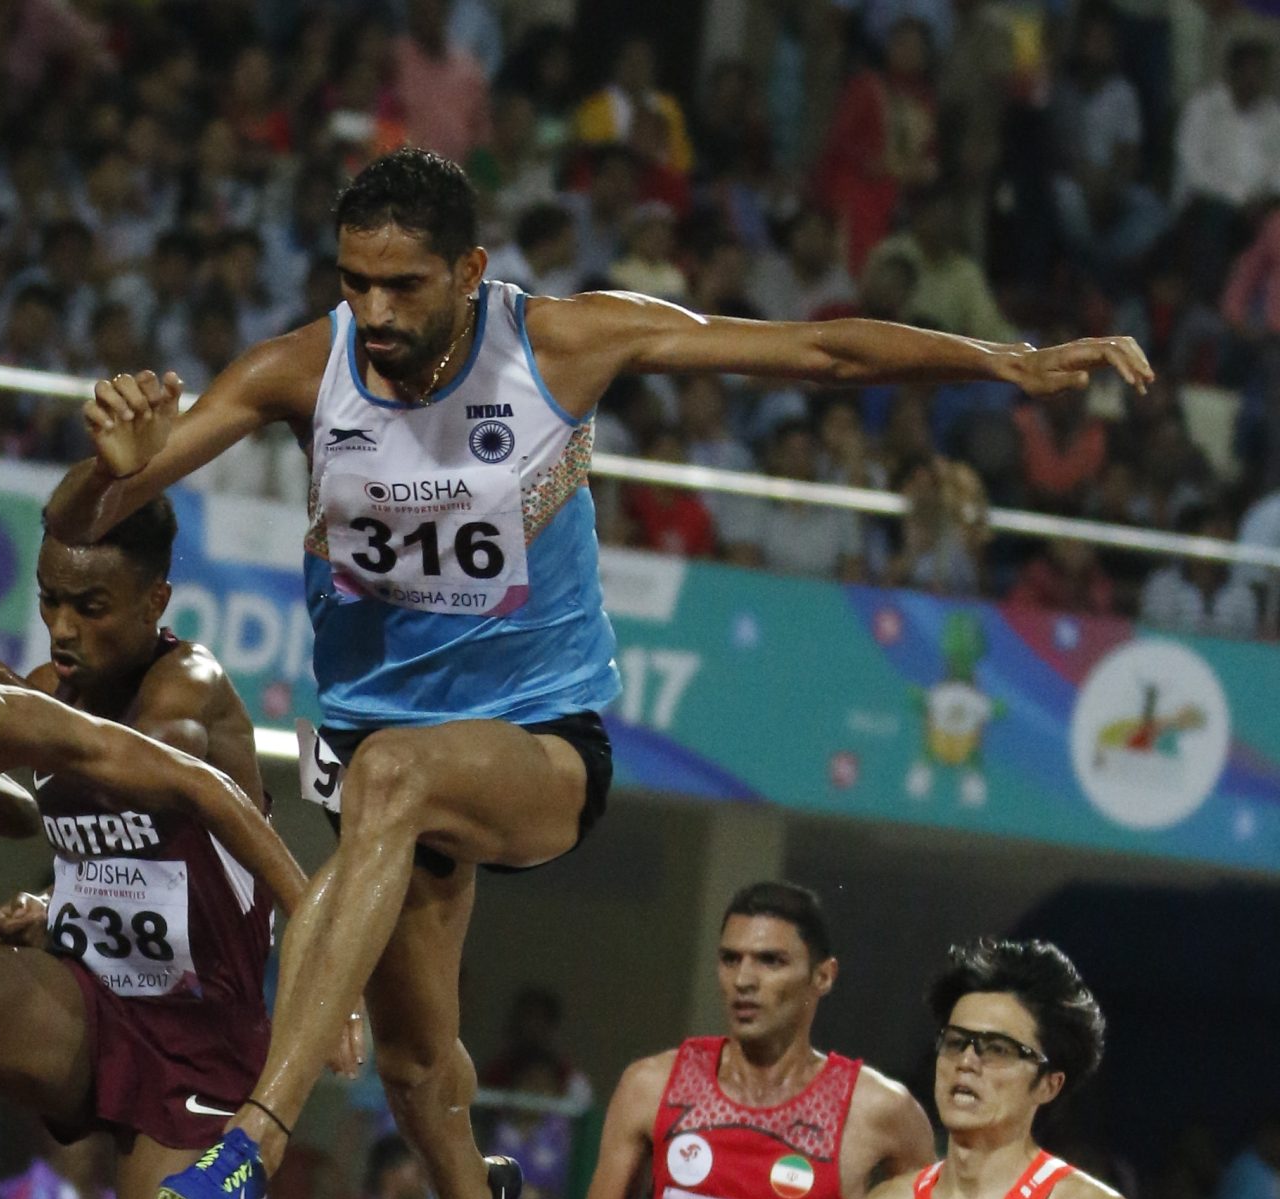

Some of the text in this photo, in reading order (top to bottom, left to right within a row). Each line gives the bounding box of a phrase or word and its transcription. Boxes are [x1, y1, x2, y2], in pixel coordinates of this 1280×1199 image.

[466, 403, 514, 419] INDIA
[365, 479, 472, 503] ODISHA
[394, 502, 472, 513] OPPORTUNITIES
[350, 517, 504, 579] 316
[451, 593, 487, 607] 2017
[43, 811, 160, 854] QATAR
[76, 861, 147, 886] ODISHA
[83, 886, 146, 899] OPPORTUNITIES
[53, 902, 174, 962] 638
[137, 972, 168, 988] 2017
